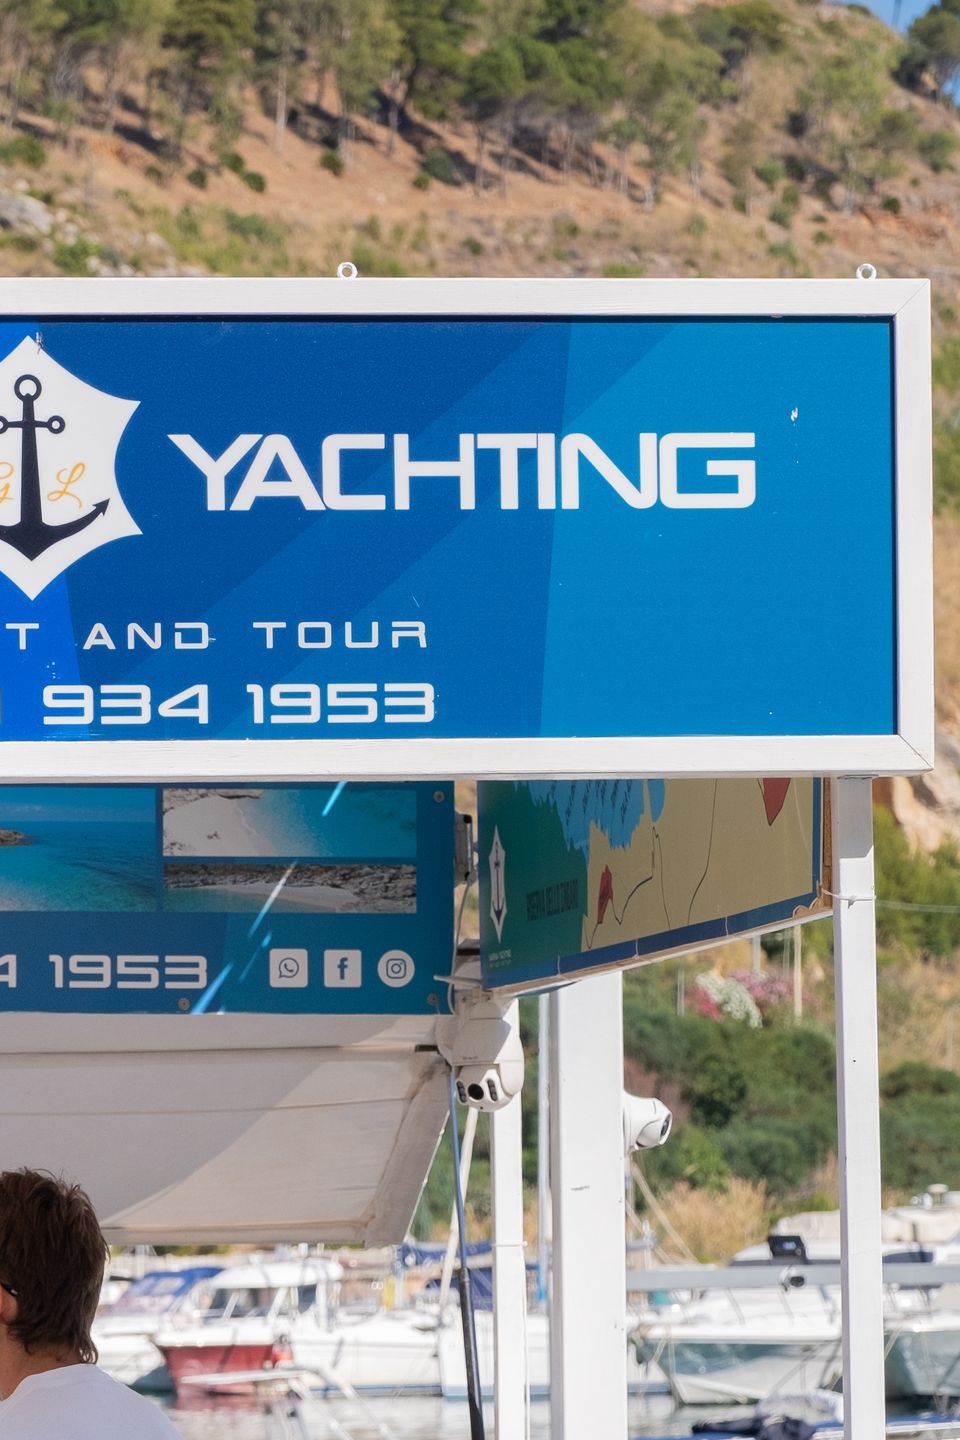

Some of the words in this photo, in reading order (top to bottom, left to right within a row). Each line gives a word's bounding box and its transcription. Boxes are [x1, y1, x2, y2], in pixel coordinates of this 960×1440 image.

[167, 432, 756, 511] YACHTING
[82, 622, 212, 649] AND
[253, 621, 427, 648] TOUR
[42, 684, 209, 725] 934
[247, 683, 436, 724] 1953
[49, 955, 208, 989] 1953
